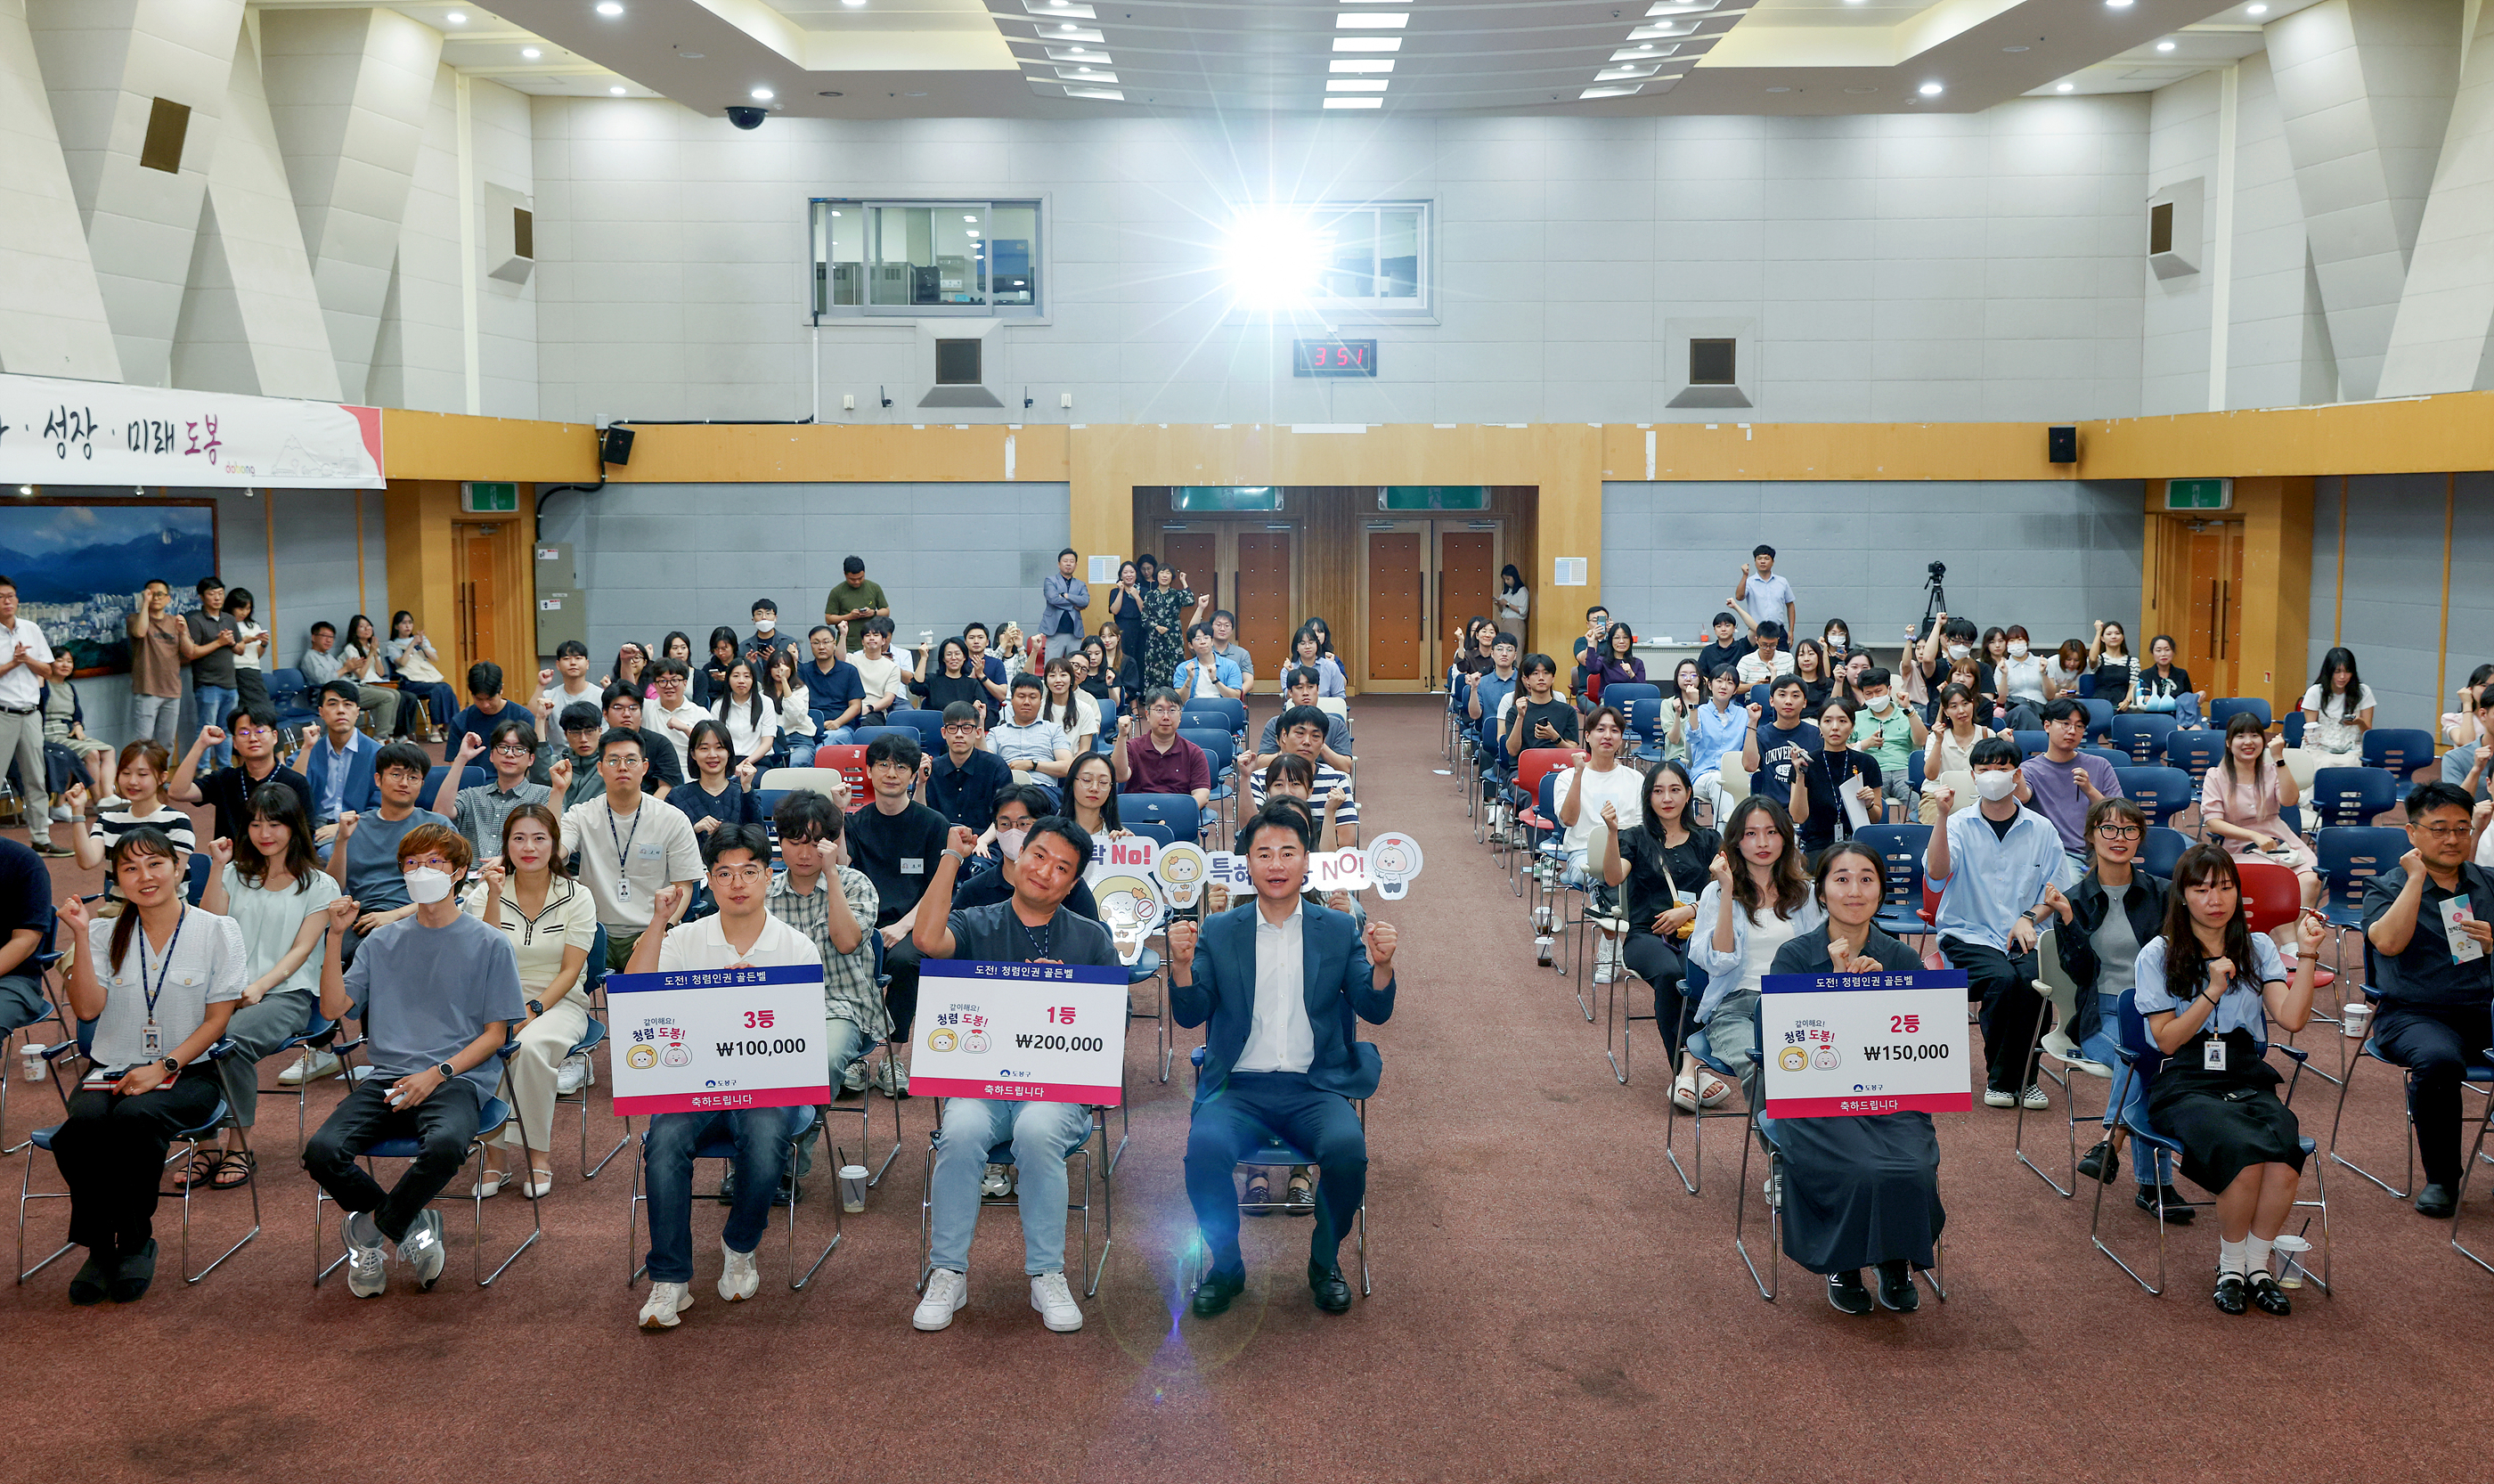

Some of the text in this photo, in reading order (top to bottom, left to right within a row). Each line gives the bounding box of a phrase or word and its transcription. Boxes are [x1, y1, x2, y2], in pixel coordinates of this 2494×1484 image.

[44, 404, 98, 461] 성장
[127, 419, 175, 454] 미래
[184, 413, 223, 466] 도봉
[225, 460, 256, 477] dobong
[1112, 844, 1151, 865] No!
[1322, 852, 1365, 880] NO!
[664, 971, 767, 986] 도전! 청렴인권 골든벨
[974, 965, 1073, 979] 도전! 청렴인권 골든벨
[1815, 974, 1913, 988] 도전! 청렴인권 골든벨
[950, 1003, 980, 1013] 같이해요!
[1047, 1006, 1076, 1025] 1등
[643, 1016, 675, 1027] 같이해요!
[744, 1009, 775, 1029] 3등
[937, 1012, 989, 1028] 청렴 도봉!
[1795, 1019, 1826, 1029] 같이해요!
[1890, 1015, 1920, 1033] 2등
[632, 1027, 686, 1042] 청렴 도봉!
[1784, 1029, 1835, 1044] 청렴 도봉!
[715, 1038, 806, 1057] ₩100,000
[1015, 1033, 1104, 1053] ₩200,000
[1863, 1043, 1950, 1063] ₩150,000
[717, 1079, 737, 1087] 도봉구
[983, 1084, 1045, 1097] 축하드립니다
[1864, 1084, 1884, 1092] 도봉구
[691, 1094, 753, 1107] 축하드립니다
[1839, 1099, 1899, 1112] 축하드립니다
